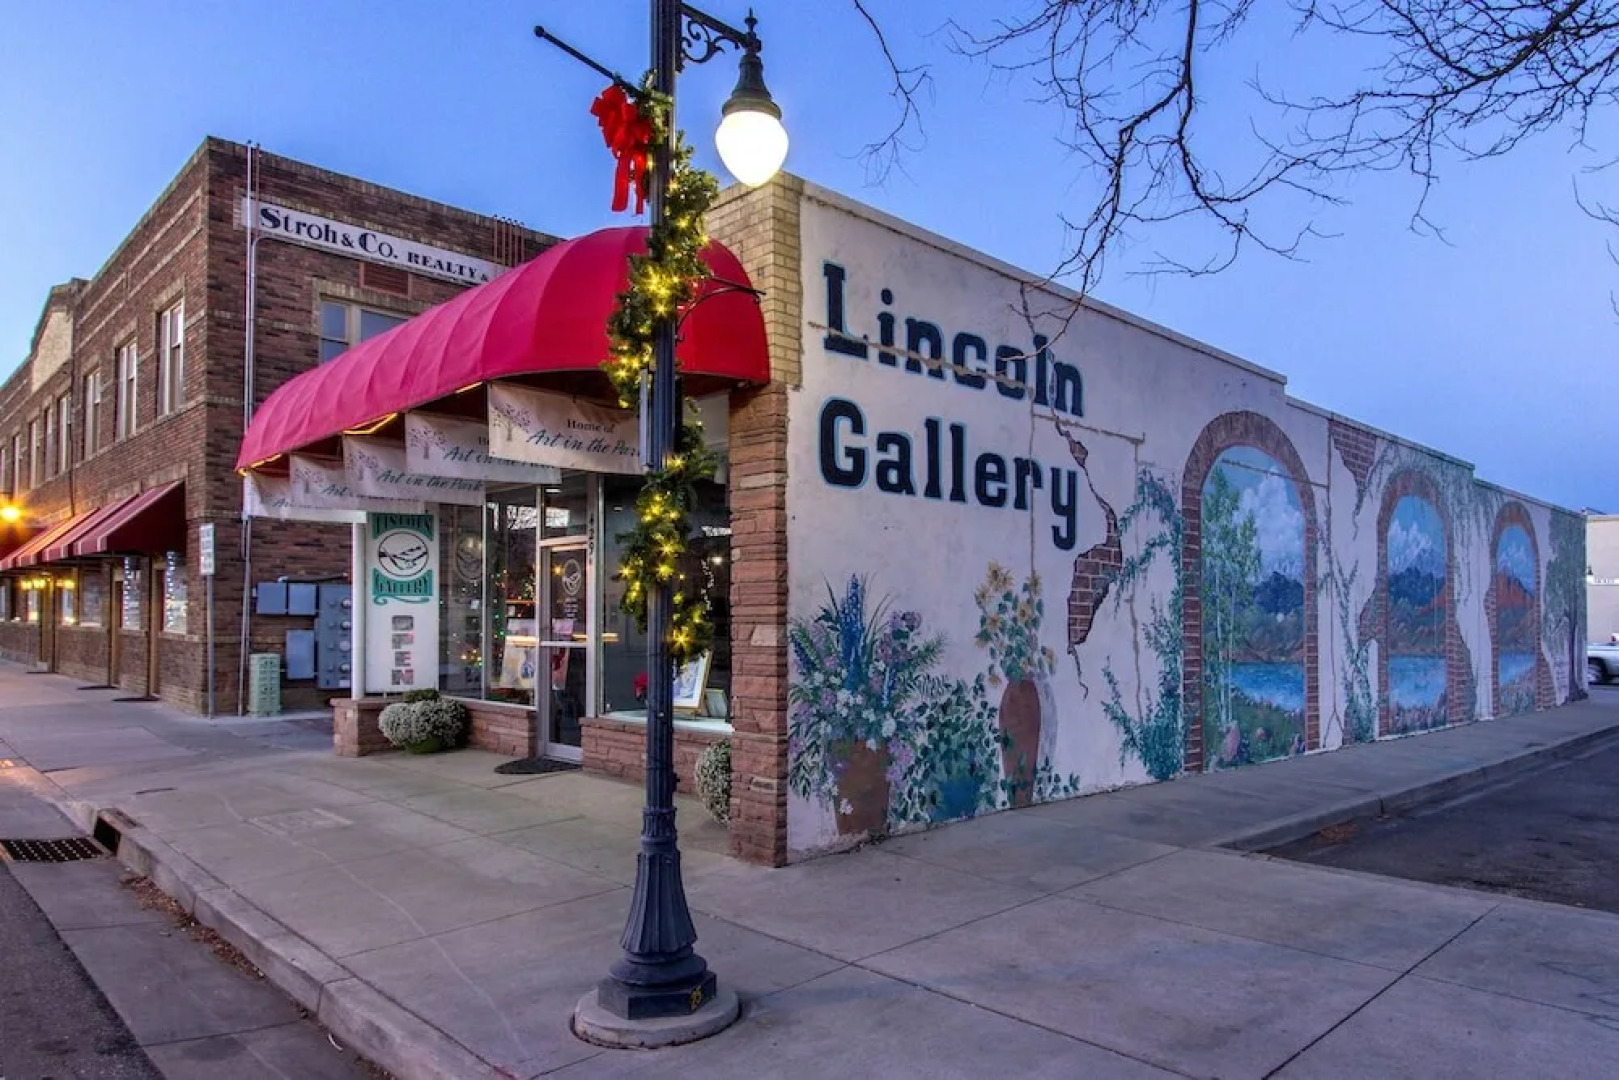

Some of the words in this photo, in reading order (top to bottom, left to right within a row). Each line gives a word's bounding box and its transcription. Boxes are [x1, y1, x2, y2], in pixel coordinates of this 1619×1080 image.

[261, 207, 338, 244] Stroh
[341, 232, 355, 250] &
[358, 232, 399, 260] Co.
[407, 251, 479, 278] REALTY
[822, 258, 1085, 419] Lincoln
[526, 428, 564, 448] Art
[564, 433, 584, 451] in
[586, 436, 611, 454] the
[611, 440, 640, 458] Par
[566, 418, 601, 432] Home
[603, 423, 615, 434] of
[443, 446, 474, 463] Art
[818, 396, 1078, 552] Gallery
[377, 469, 405, 484] Art
[426, 475, 448, 488] the
[448, 478, 484, 492] Park
[391, 614, 415, 686] OPEN
